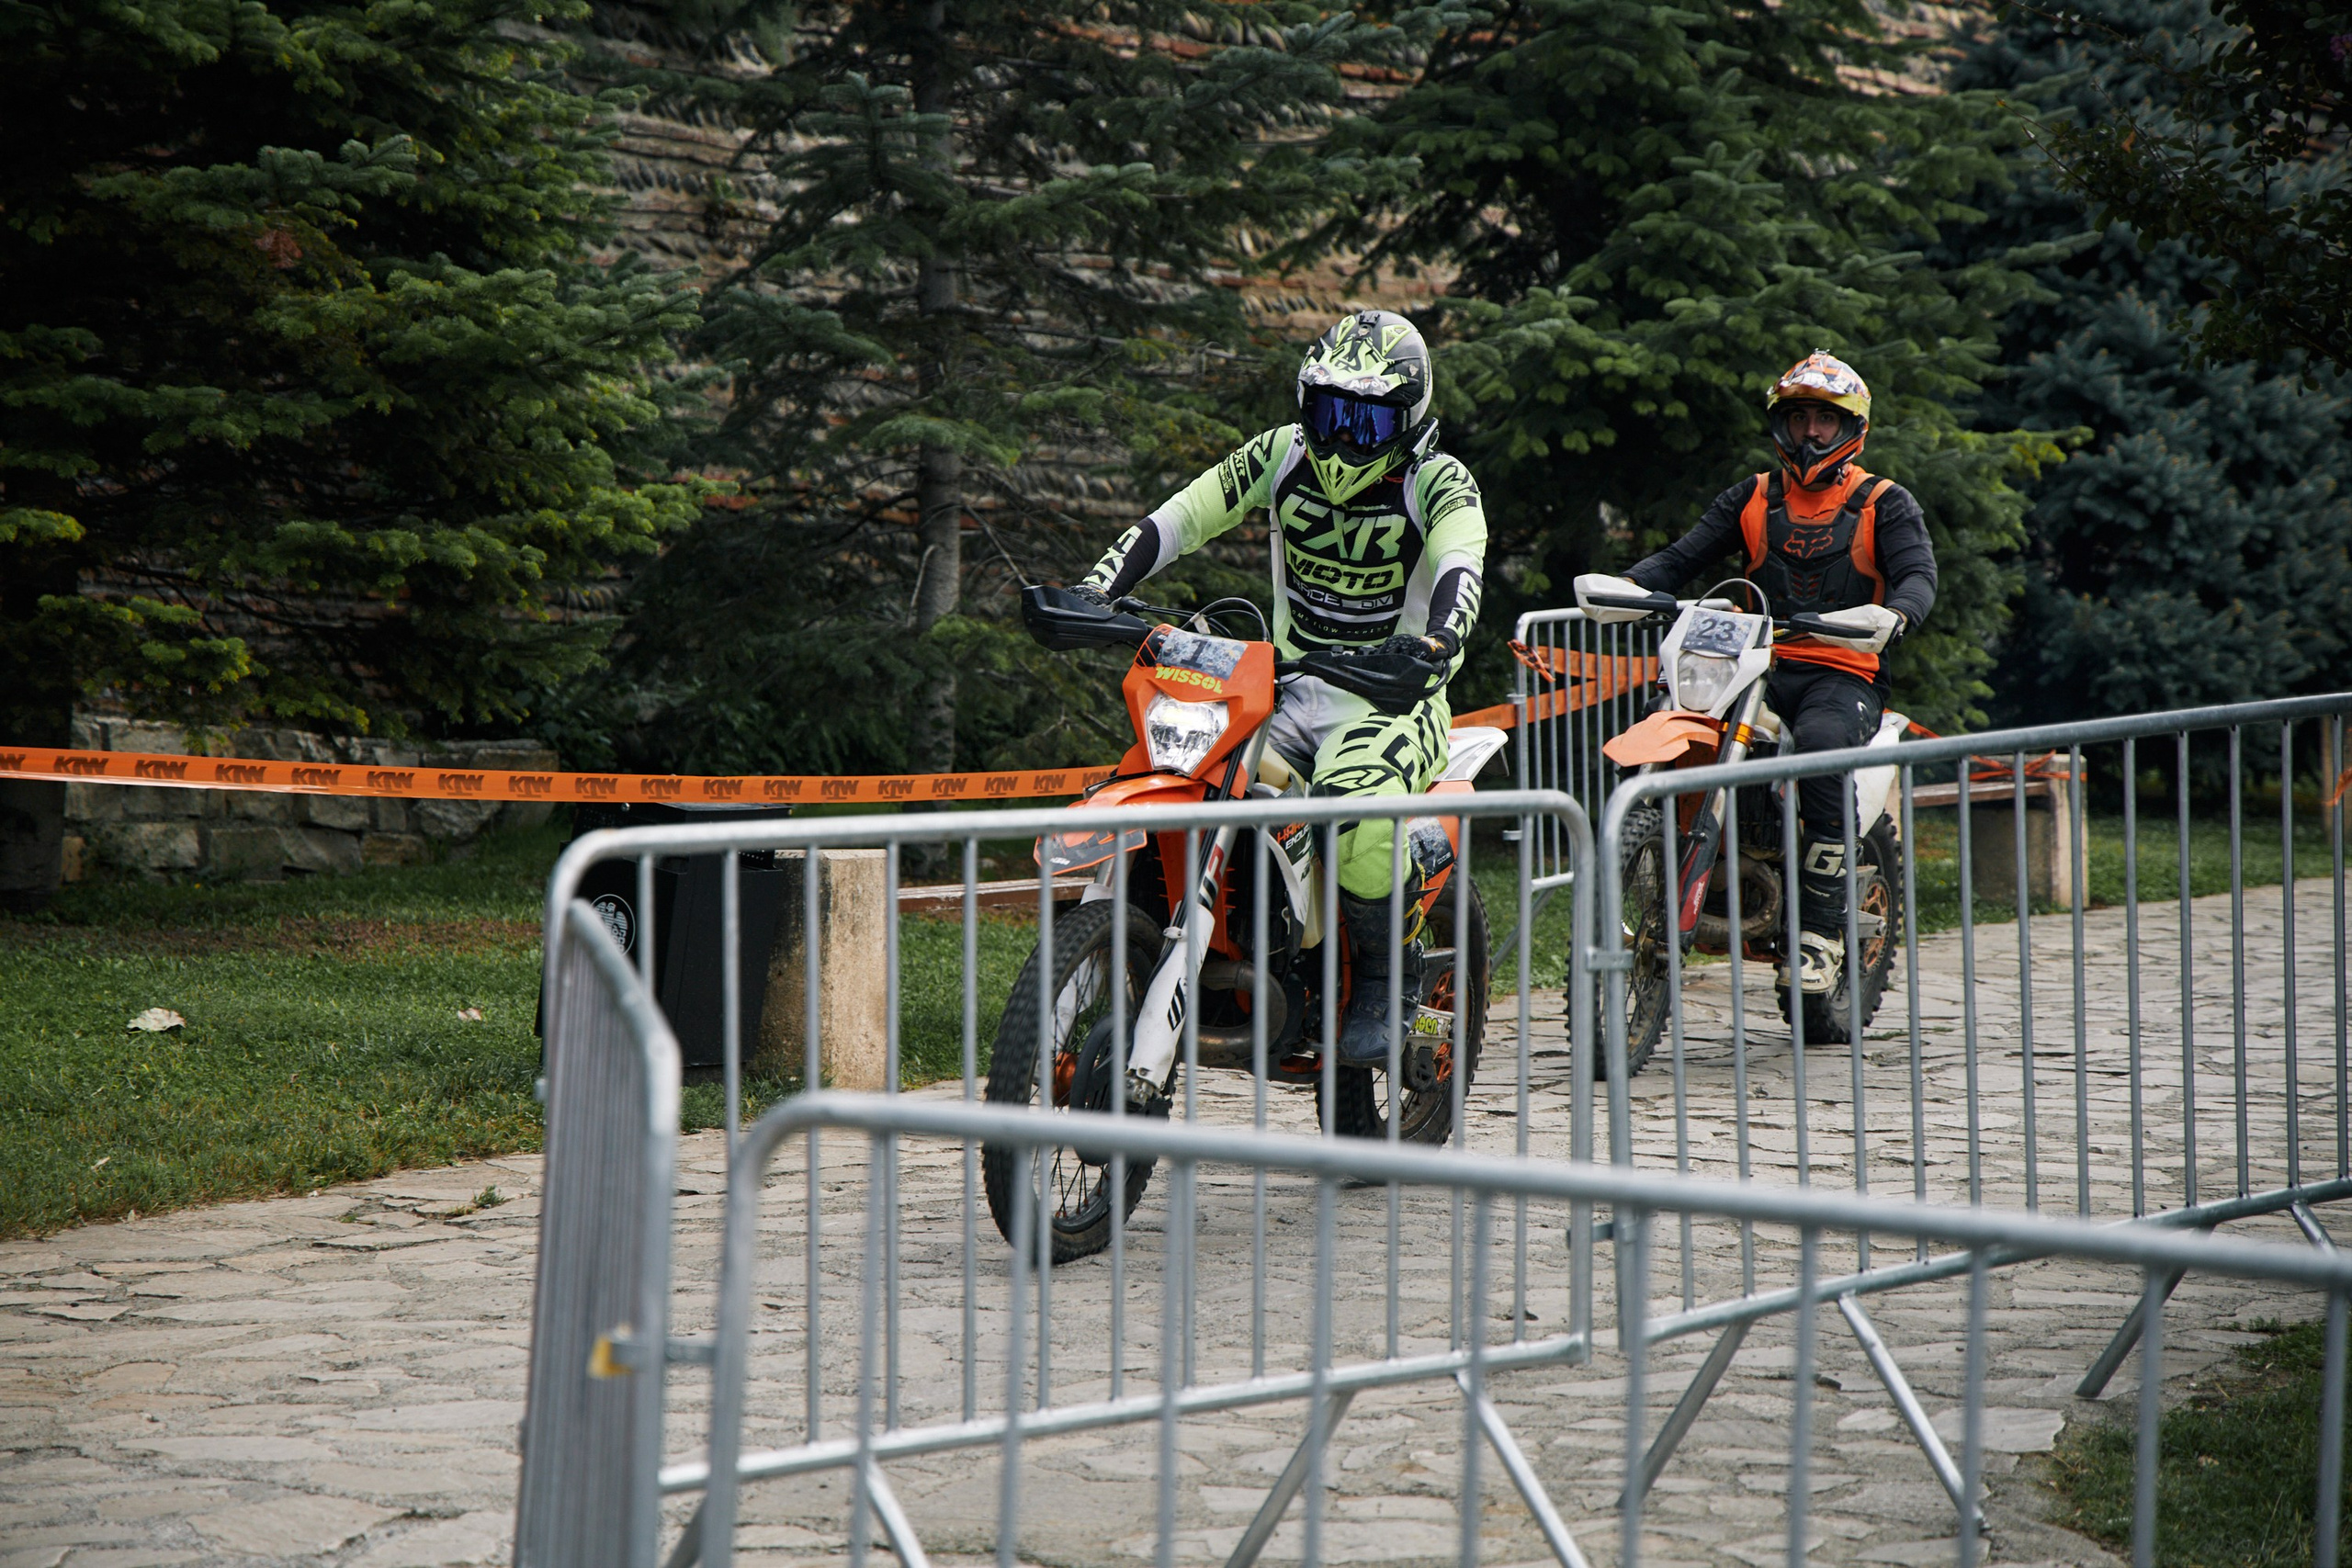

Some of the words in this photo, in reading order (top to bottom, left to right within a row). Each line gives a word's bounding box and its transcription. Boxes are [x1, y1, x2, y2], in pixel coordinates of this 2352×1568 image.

[1279, 492, 1408, 561] FXR
[1290, 549, 1395, 591] MOTO
[1292, 574, 1340, 606] RACE
[1361, 595, 1394, 609] DIV
[1696, 618, 1736, 641] 23
[1155, 666, 1224, 694] WISSOL
